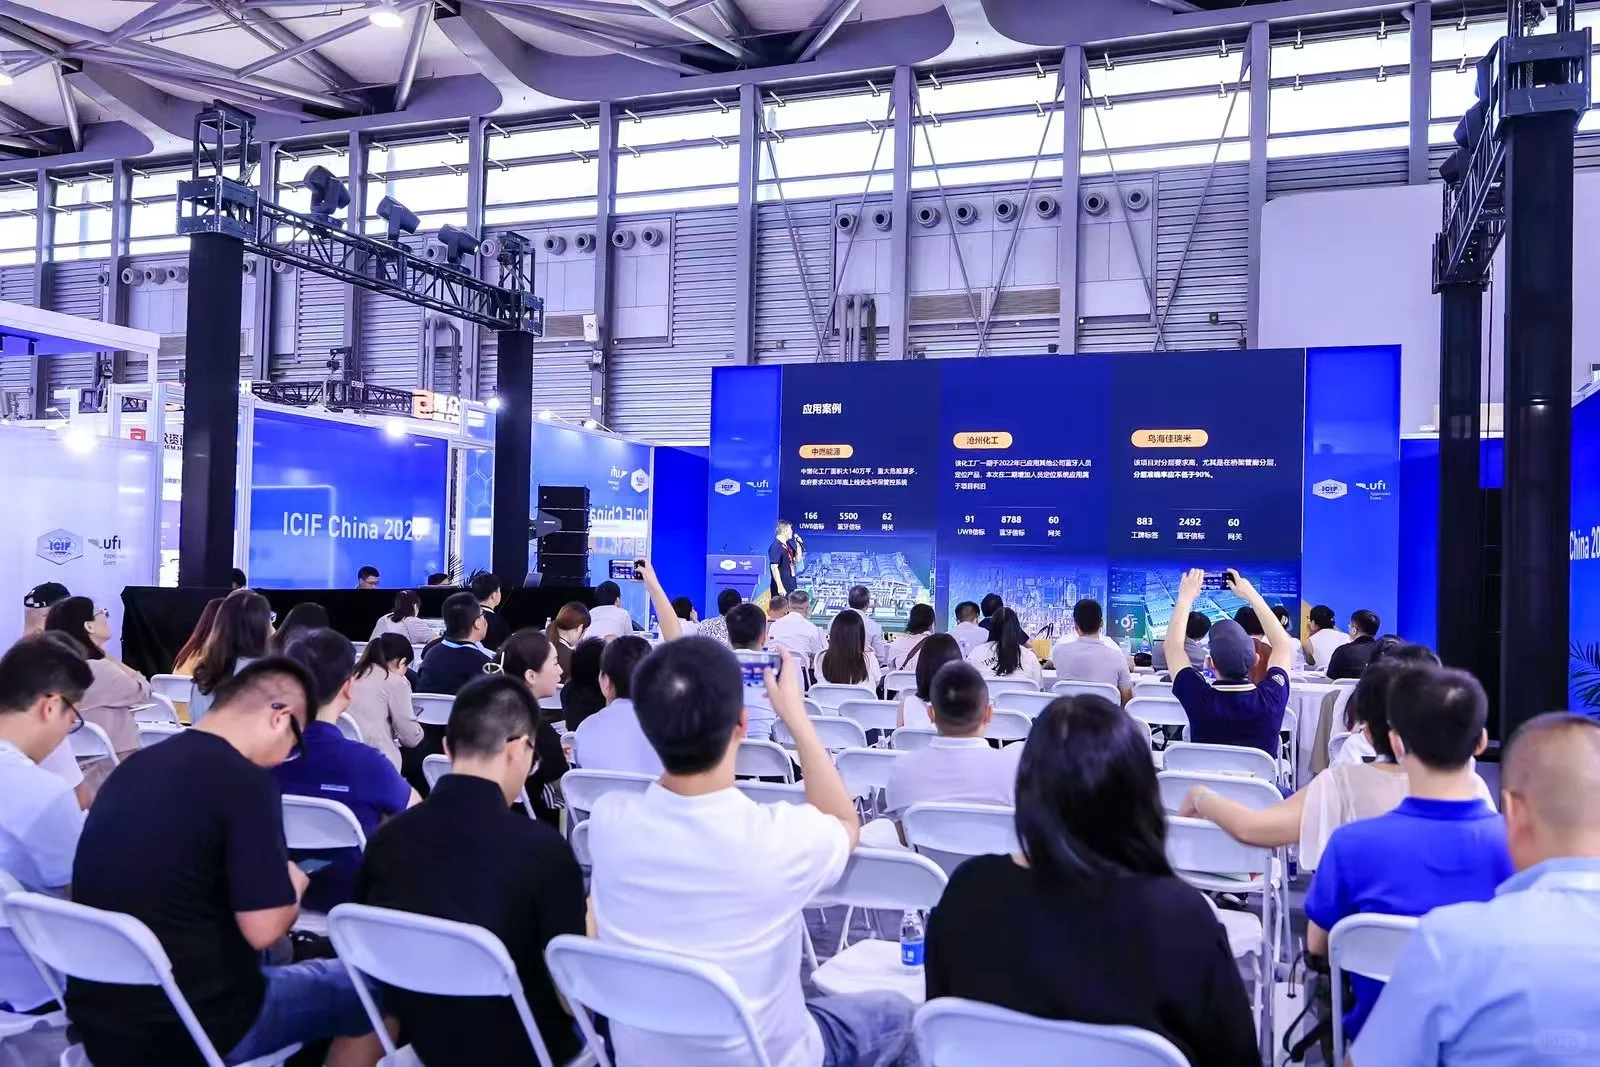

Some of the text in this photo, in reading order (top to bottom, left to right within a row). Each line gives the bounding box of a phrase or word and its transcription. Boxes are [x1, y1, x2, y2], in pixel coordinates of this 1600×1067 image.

[802, 403, 842, 415] 应用案例
[966, 436, 999, 445] 沧州化工
[1147, 434, 1192, 443] 乌海佳瑞米
[811, 447, 841, 456] 中燃能源
[1133, 471, 1214, 479] 分层准确率应不低于90%。
[1369, 480, 1386, 490] ufi
[804, 512, 893, 521] 166 5500 62
[964, 515, 1059, 524] 91 8788 60
[283, 511, 323, 537] ICIF
[328, 515, 378, 540] China
[1136, 517, 1240, 527] 883 2492 60
[799, 523, 894, 531] UWB信标 蓝牙信标 网关
[957, 528, 1061, 537] UWB信标 蓝牙信标 网关
[1131, 531, 1242, 541] 工牌标签 蓝牙信标 网关
[49, 541, 71, 551] ICIF
[103, 535, 121, 550] ufi
[1569, 529, 1590, 561] China
